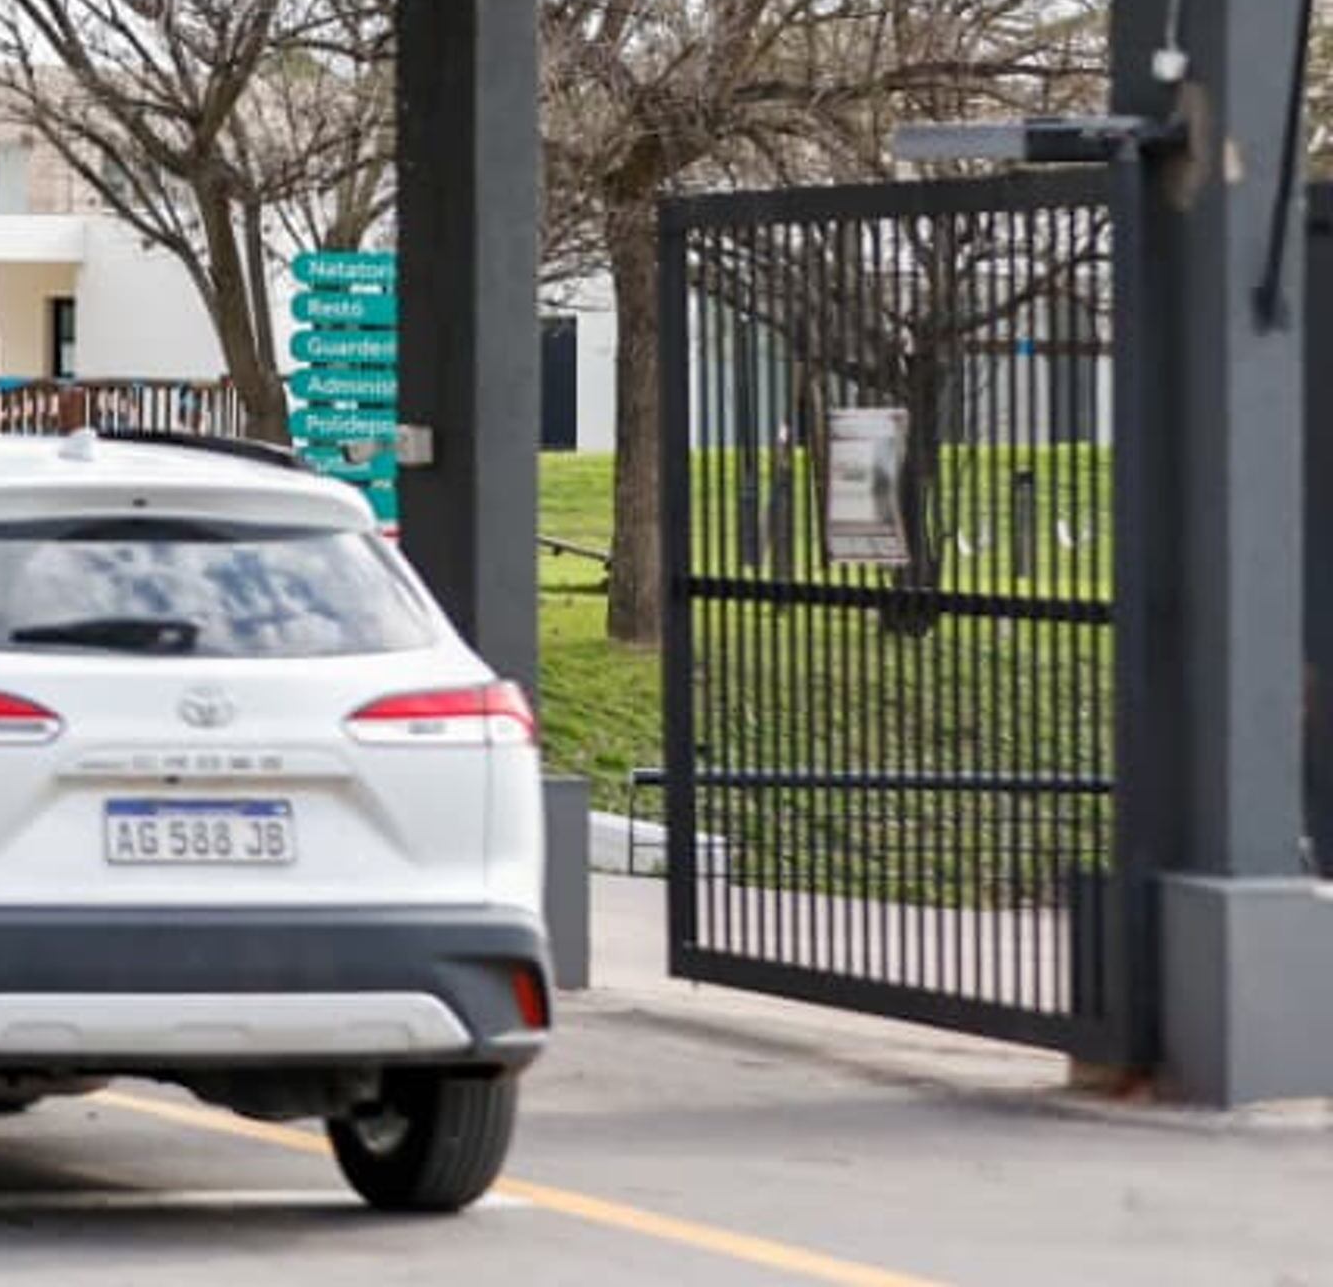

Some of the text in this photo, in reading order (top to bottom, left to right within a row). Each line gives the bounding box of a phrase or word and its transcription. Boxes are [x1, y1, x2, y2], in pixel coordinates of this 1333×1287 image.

[117, 821, 287, 856] AG 588 JB
